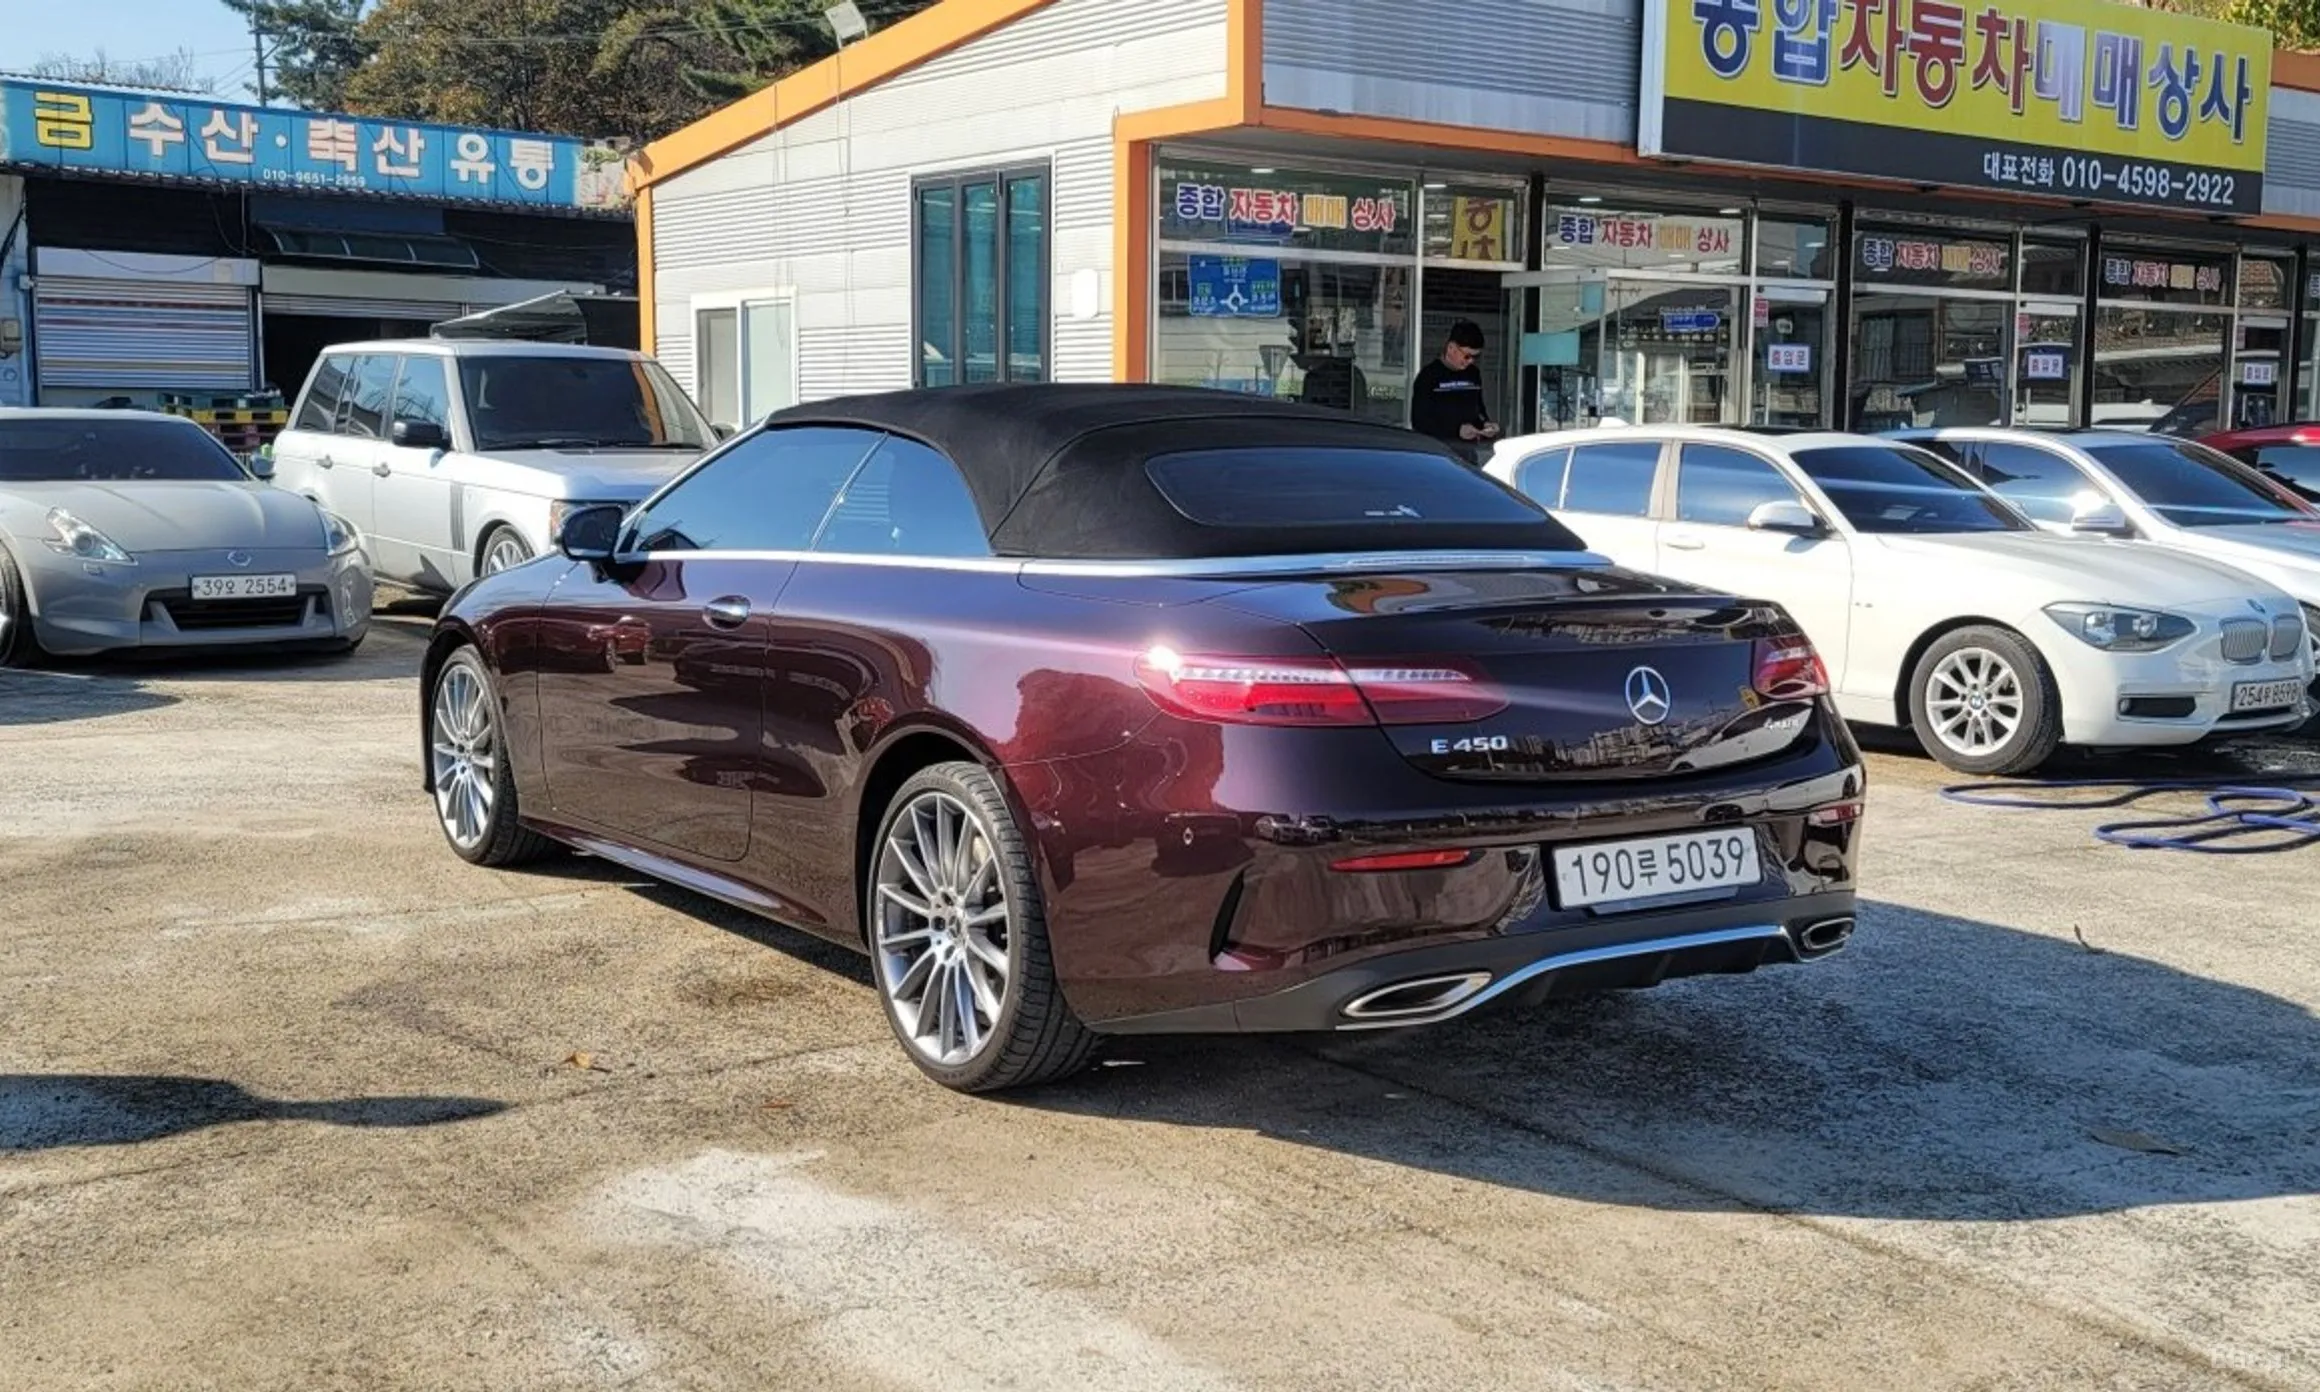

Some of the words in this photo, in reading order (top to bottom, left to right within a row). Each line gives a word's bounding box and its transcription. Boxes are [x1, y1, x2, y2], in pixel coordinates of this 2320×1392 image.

[33, 91, 93, 150] 금
[1983, 151, 2056, 187] 대표전화
[2061, 156, 2235, 205] 010-4598-2922
[1176, 183, 1226, 220] 종합
[1229, 188, 1298, 226] 자동차
[1351, 197, 1396, 232] 상사
[1559, 214, 1596, 245] 종합
[1601, 218, 1653, 249] 자동차
[1697, 227, 1730, 253] 상사
[1431, 738, 1449, 754] E
[1453, 735, 1508, 752] 450
